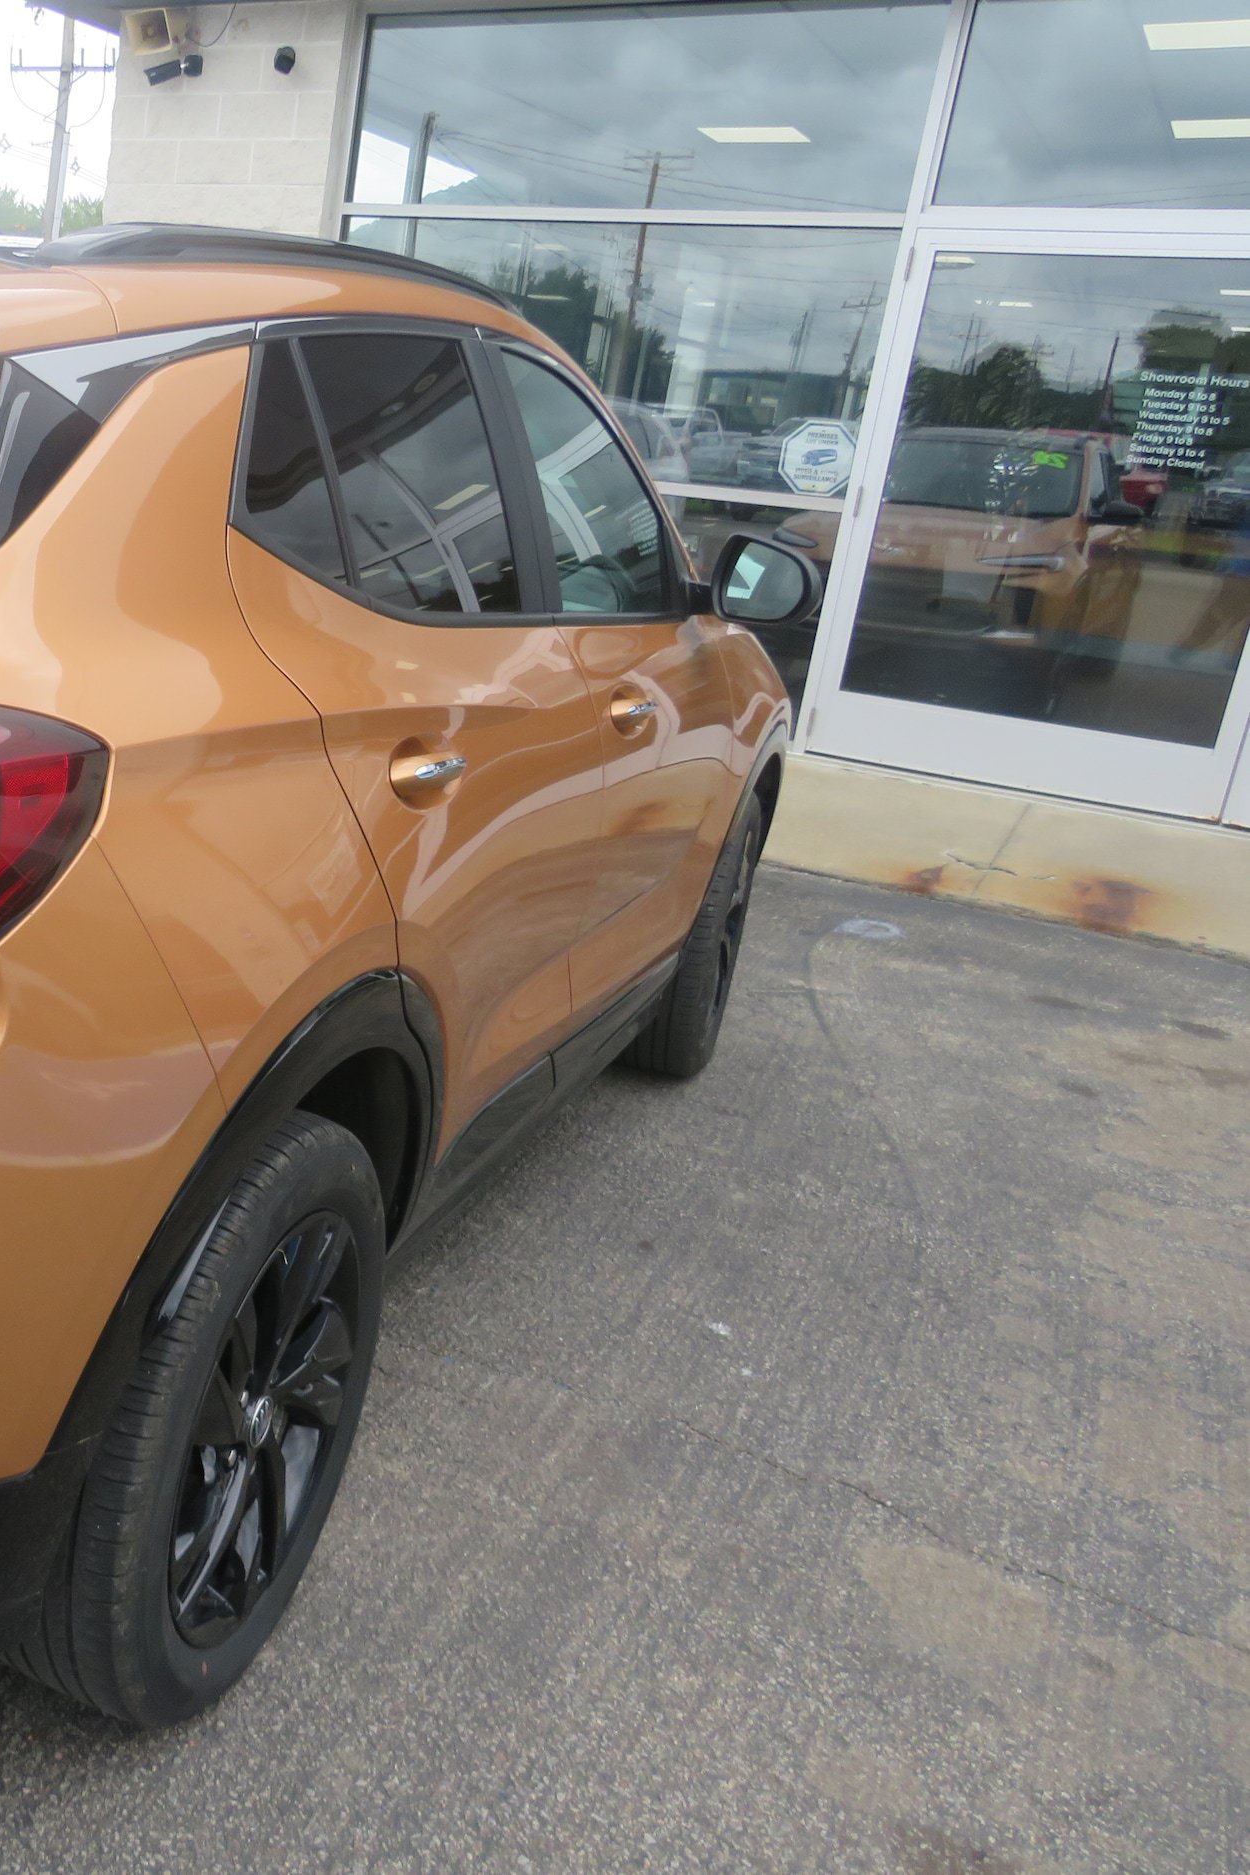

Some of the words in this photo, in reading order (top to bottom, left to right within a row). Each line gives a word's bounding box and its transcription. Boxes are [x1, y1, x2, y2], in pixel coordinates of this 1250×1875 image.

[1140, 371, 1207, 386] Showroom
[1210, 375, 1249, 388] Hours
[1144, 388, 1187, 400] Monday
[1188, 391, 1196, 399] 9
[1197, 392, 1208, 401] to
[1208, 393, 1217, 401] 8
[1142, 399, 1187, 412] Tuesday
[1188, 403, 1195, 411] 9
[1196, 404, 1207, 412] to
[1208, 404, 1217, 413] 5
[1138, 410, 1200, 426] Wednesday
[1201, 415, 1209, 424] 9
[1209, 416, 1221, 425] to
[1221, 417, 1230, 426] 5
[1135, 421, 1186, 435] Thursday
[1194, 426, 1205, 435] to
[1131, 432, 1165, 445] Friday
[1166, 436, 1173, 444] 9
[1174, 437, 1186, 445] to
[1186, 437, 1194, 446] 8
[1129, 443, 1175, 457] Saturday
[1176, 447, 1184, 456] 9
[1185, 447, 1197, 457] to
[1197, 449, 1206, 458] 4
[1125, 454, 1166, 468] Sunday
[1166, 457, 1205, 470] Closed
